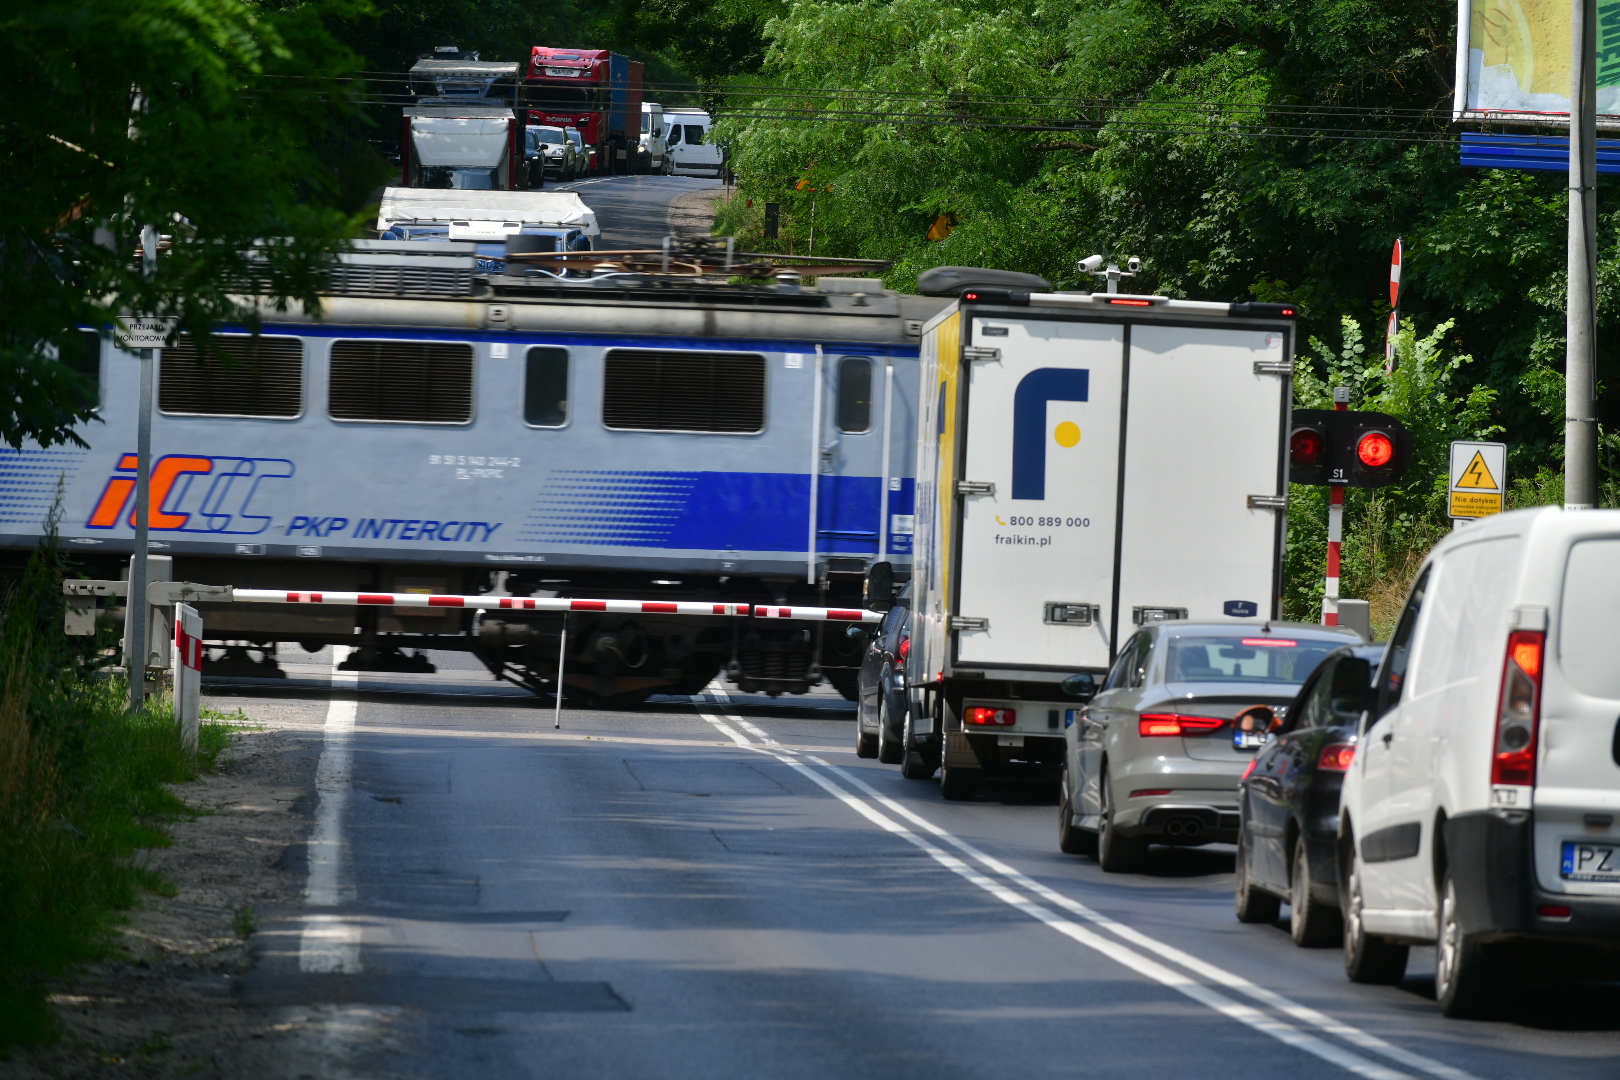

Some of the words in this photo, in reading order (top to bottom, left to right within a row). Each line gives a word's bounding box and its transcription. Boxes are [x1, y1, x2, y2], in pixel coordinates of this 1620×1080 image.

[129, 323, 164, 331] PRZEJAD
[1333, 468, 1344, 479] S1
[1469, 496, 1498, 505] dotykać
[1009, 515, 1035, 527] 800
[1037, 516, 1063, 528] 889
[1066, 517, 1091, 528] 000
[285, 516, 348, 539] PKP
[352, 518, 503, 543] INTERCITY
[994, 533, 1052, 548] fraikin.pl
[1578, 846, 1614, 872] PZ
